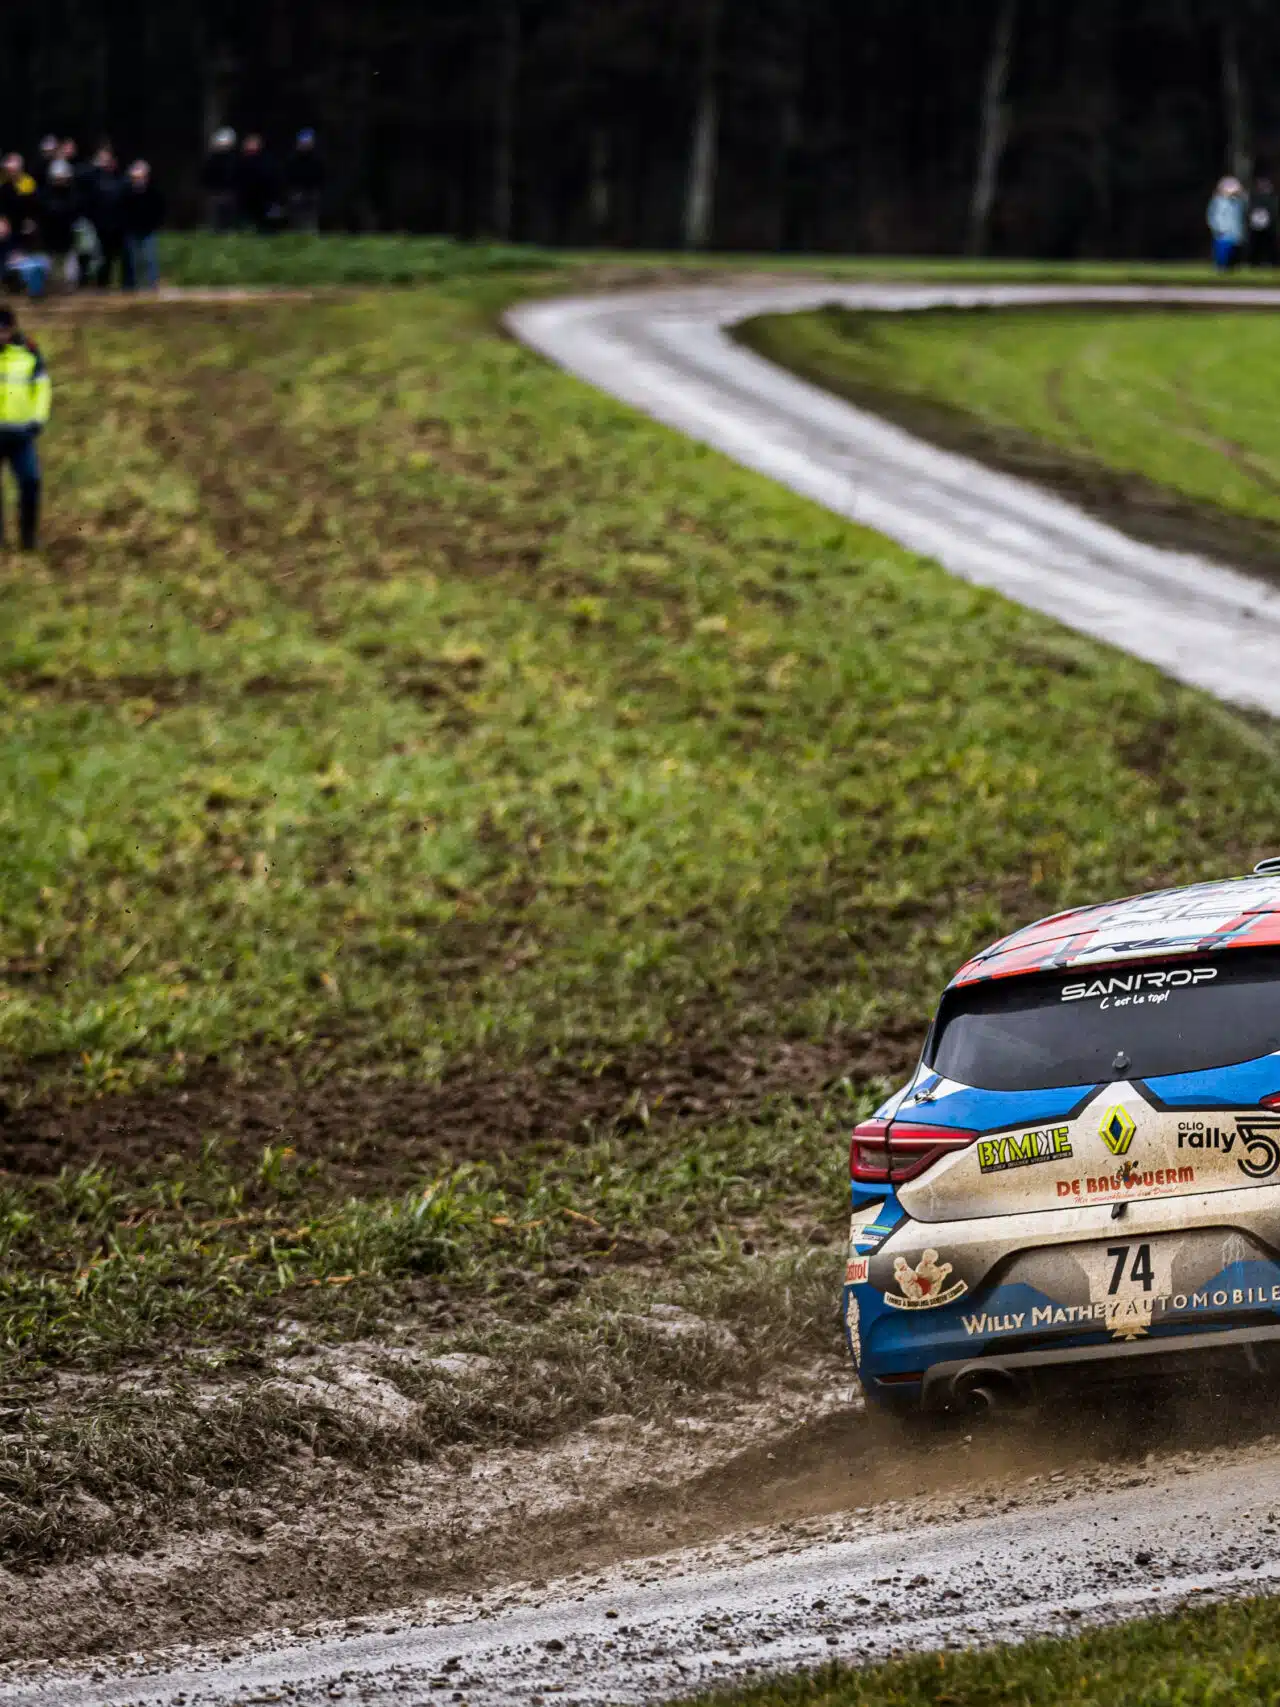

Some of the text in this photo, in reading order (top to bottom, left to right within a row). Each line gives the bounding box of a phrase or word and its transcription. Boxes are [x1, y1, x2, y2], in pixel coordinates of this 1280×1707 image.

[1178, 1121, 1204, 1131] CLIO
[1177, 1116, 1280, 1179] rally 5
[1056, 1178, 1080, 1197] DE
[1106, 1243, 1155, 1296] 74
